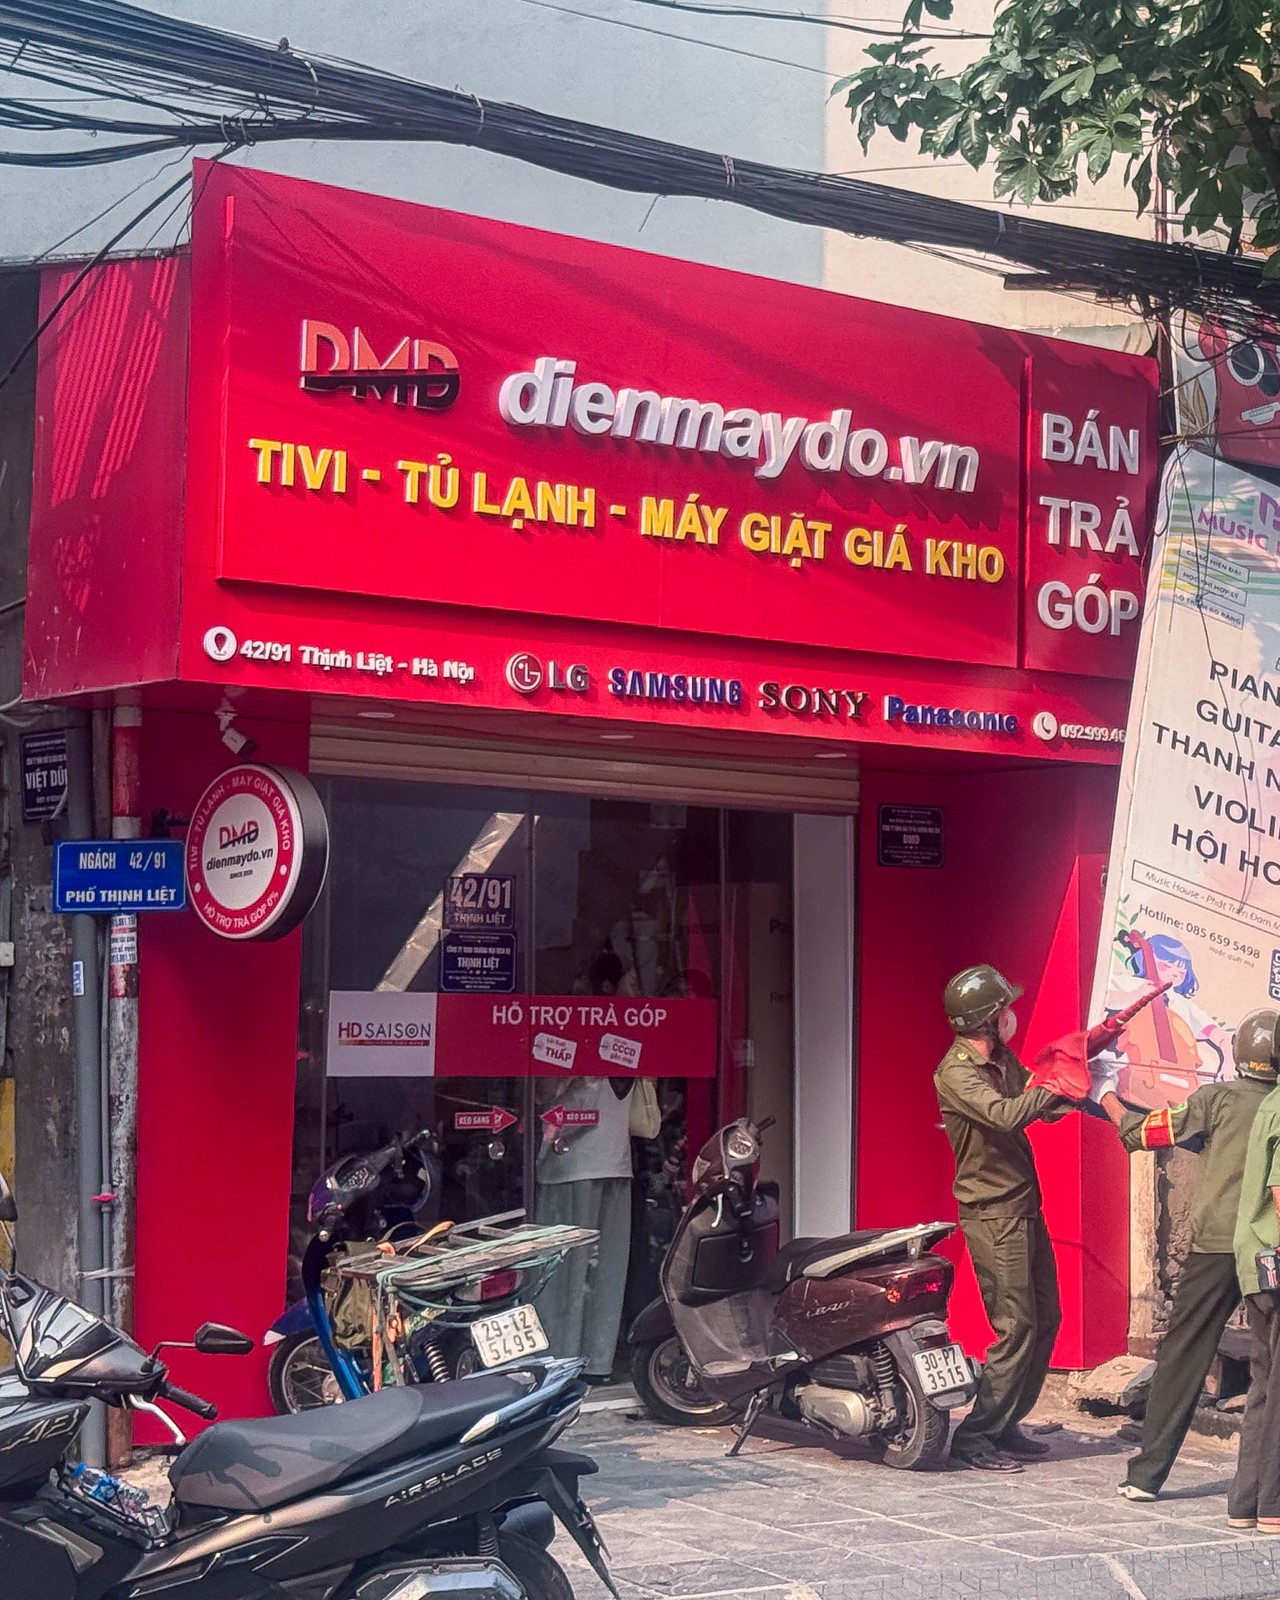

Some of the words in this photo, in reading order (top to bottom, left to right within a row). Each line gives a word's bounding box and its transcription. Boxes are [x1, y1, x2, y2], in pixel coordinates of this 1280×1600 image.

[499, 356, 980, 494] dienmaydo.vn
[1041, 409, 1140, 476] BÁN
[248, 437, 348, 494] TIVI
[397, 453, 461, 509] TỦ
[472, 471, 597, 530] LẠNH
[641, 493, 729, 546] MÁY
[740, 512, 832, 569] GIẶT
[844, 524, 912, 573] GIÁ
[925, 538, 1004, 584] KHO
[1039, 496, 1140, 558] TRẢ
[1197, 508, 1270, 551] MUSIC
[1037, 574, 1140, 636] GÓP
[239, 639, 292, 663] 42/91
[298, 646, 352, 671] Thịnh
[356, 652, 394, 676] Liệt
[412, 658, 439, 678] Hà
[443, 660, 475, 685] Nội
[547, 660, 590, 691] LG
[607, 667, 743, 706] SAMSUNG
[758, 681, 868, 718] SONY
[883, 695, 1019, 734] Panasonic
[1152, 721, 1255, 781] THANH
[25, 767, 48, 792] VIỆT
[280, 818, 291, 850] KHO
[1171, 824, 1228, 866] HỘI
[79, 848, 116, 870] NGÁCH
[129, 851, 166, 872] 42/91
[206, 848, 274, 871] dienmaydo.vn
[66, 885, 97, 903] PHỐ
[100, 889, 143, 905] THỊNH
[147, 885, 177, 905] LIỆT
[450, 878, 511, 909] 42/91
[1144, 871, 1170, 888] Music
[1172, 880, 1200, 899] House
[454, 913, 484, 925] THỊNH
[486, 912, 507, 926] LIỆT
[1138, 903, 1184, 931] Hotline:
[1186, 922, 1207, 939] 085
[1209, 931, 1231, 949] 659
[1233, 941, 1261, 960] 5498
[457, 957, 481, 970] THỊNH
[483, 956, 500, 970] LIỆT
[492, 1001, 523, 1025] HỖ
[529, 1006, 573, 1030] TRỢ
[624, 1003, 667, 1027] GÓP
[545, 1047, 572, 1062] THẤP
[481, 1311, 532, 1341] 29-T2
[488, 1330, 537, 1361] 5495
[921, 1347, 956, 1371] 30-P7
[928, 1366, 965, 1390] 3515
